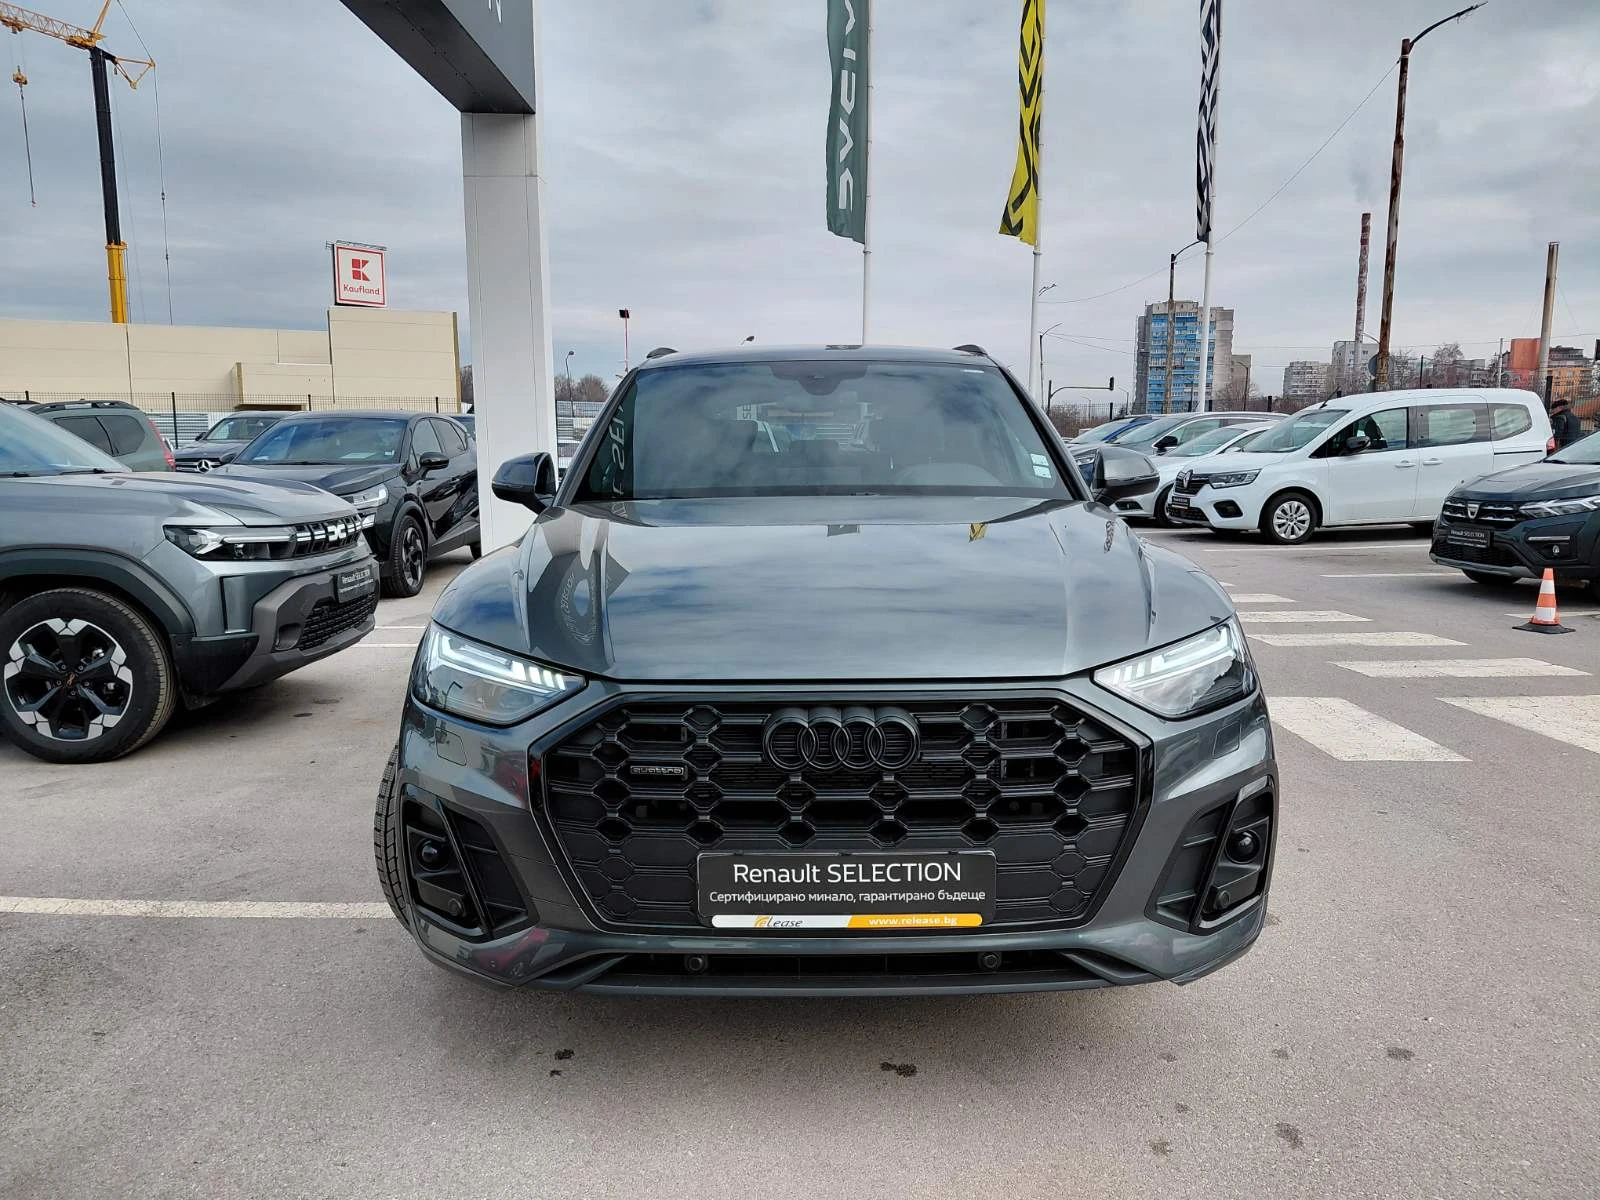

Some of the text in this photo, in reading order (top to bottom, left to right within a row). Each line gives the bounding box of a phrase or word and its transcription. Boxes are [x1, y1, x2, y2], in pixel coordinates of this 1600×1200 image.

[343, 284, 380, 295] Kaufland
[733, 862, 961, 883] Renault SELECTION
[709, 889, 986, 904] Сертифицирано минало, гарантирано бъдеще
[868, 915, 958, 926] www.release.bg
